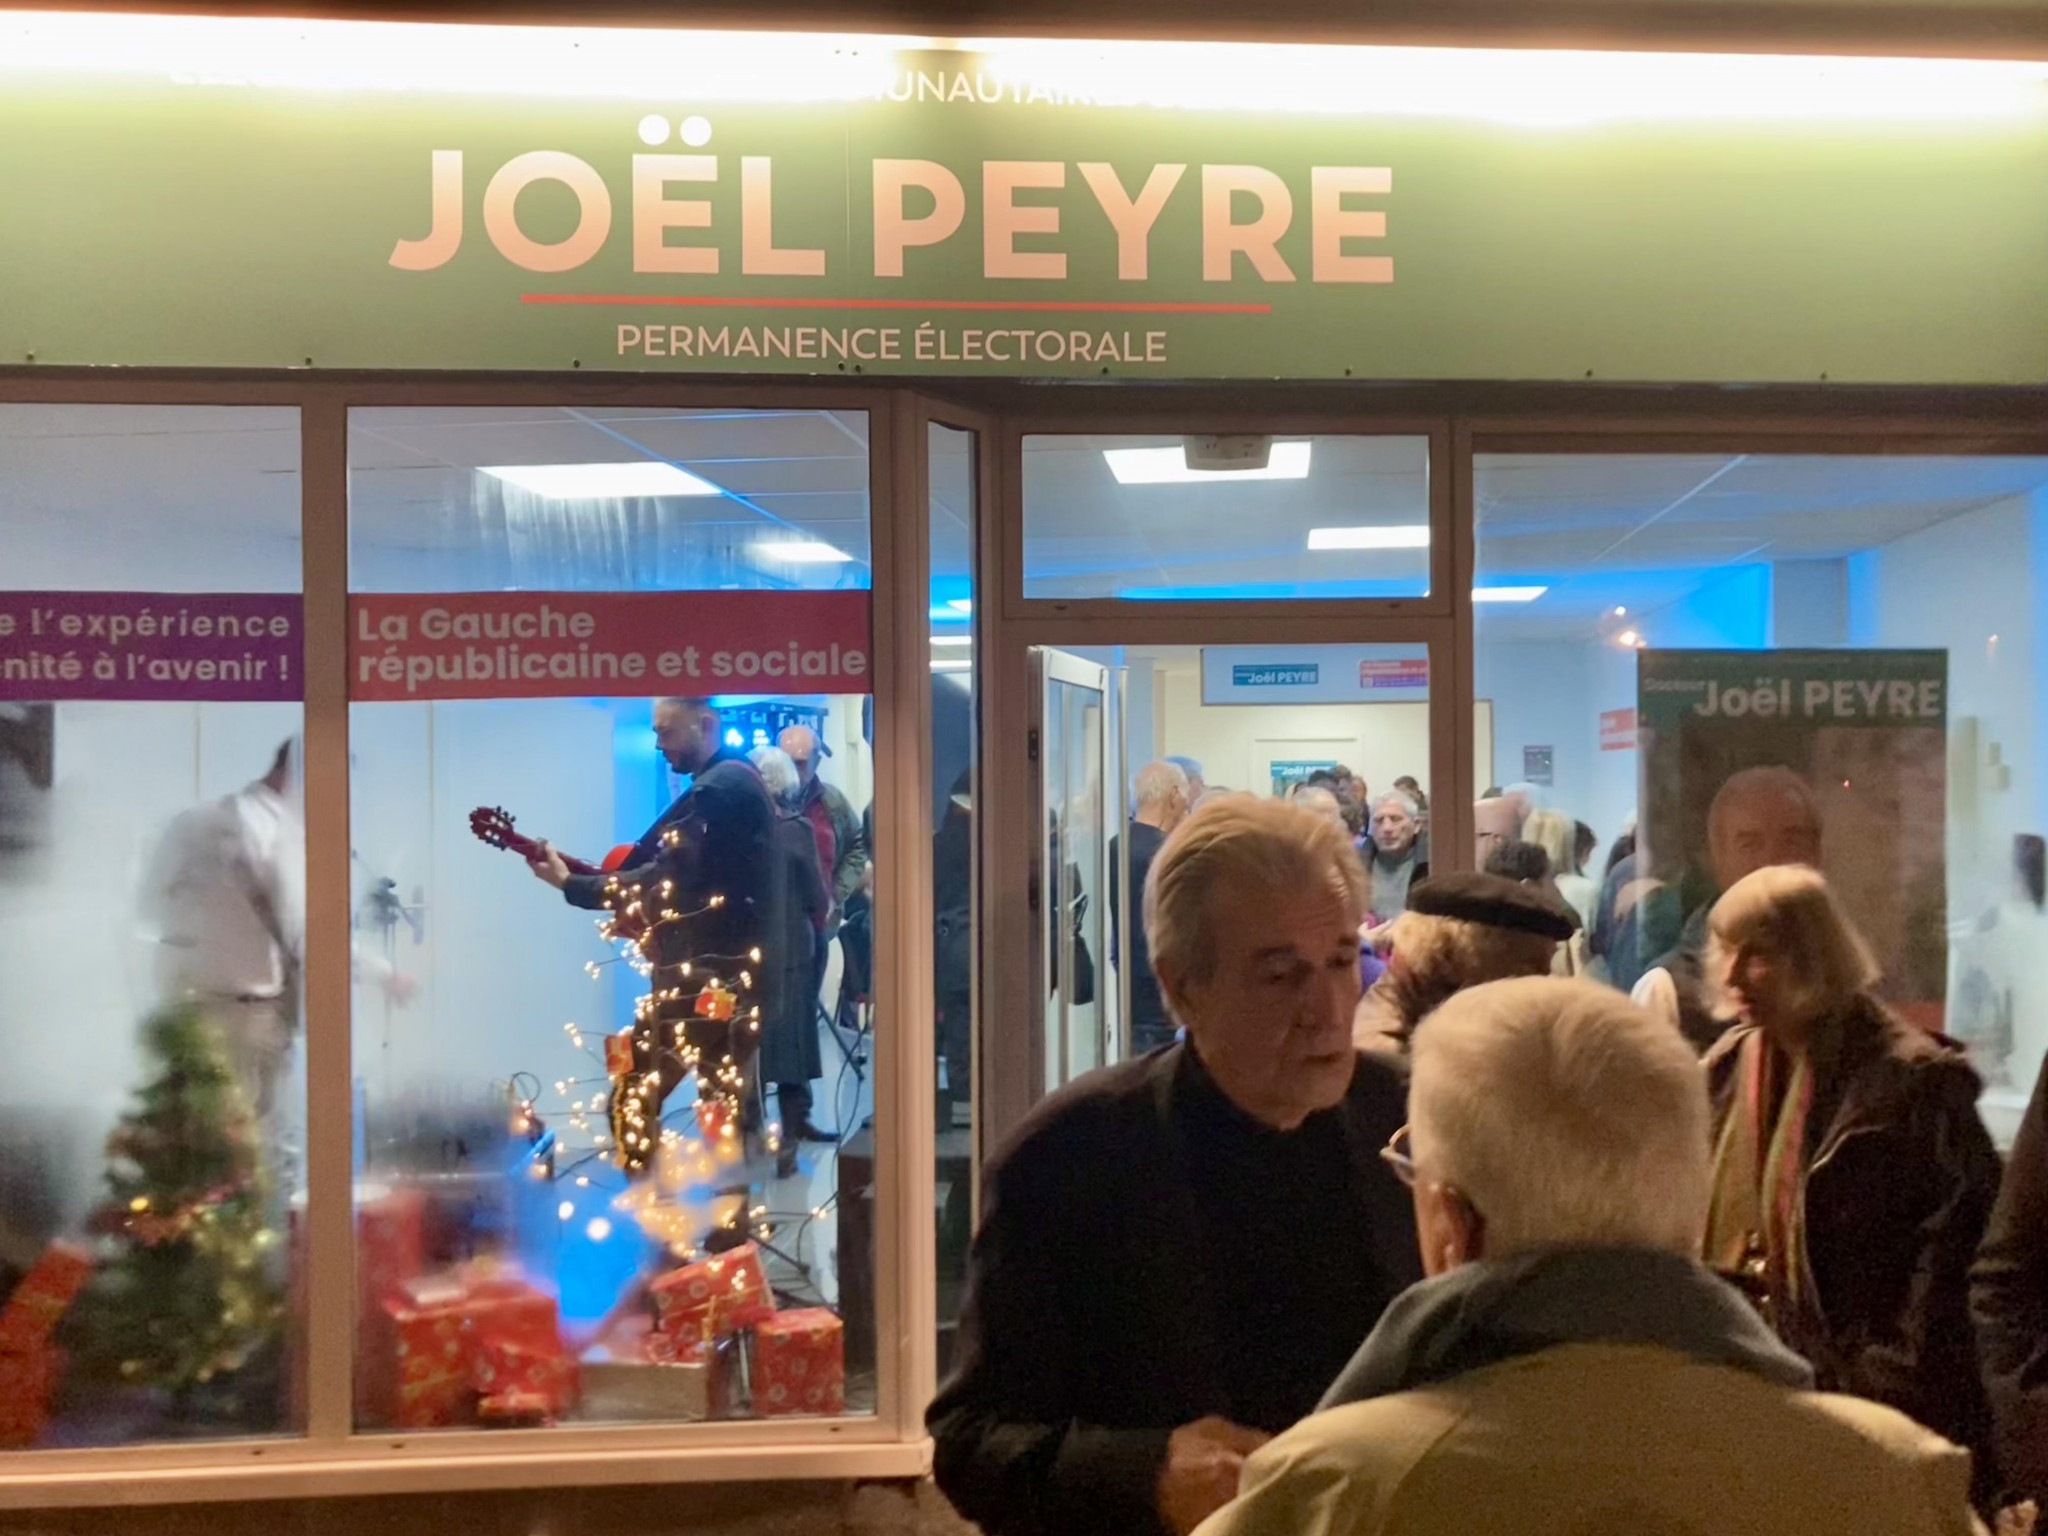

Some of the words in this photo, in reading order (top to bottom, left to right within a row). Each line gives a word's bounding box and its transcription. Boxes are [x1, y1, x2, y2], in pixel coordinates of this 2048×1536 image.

[388, 114, 826, 276] JOËL
[872, 158, 1395, 284] PEYRE
[616, 324, 902, 361] PERMANENCE
[914, 321, 1168, 363] ÉLECTORALE
[31, 608, 290, 645] l'expérience
[358, 608, 408, 641] La
[420, 605, 595, 640] Gauche
[0, 651, 82, 680] nité
[94, 652, 116, 680] à
[127, 652, 268, 681] l'avenir
[279, 654, 289, 681] !
[358, 643, 646, 692] républicaine
[656, 645, 701, 677] et
[710, 641, 867, 677] sociale
[1692, 677, 1791, 718] Joël
[1803, 679, 1942, 718] PEYRE
